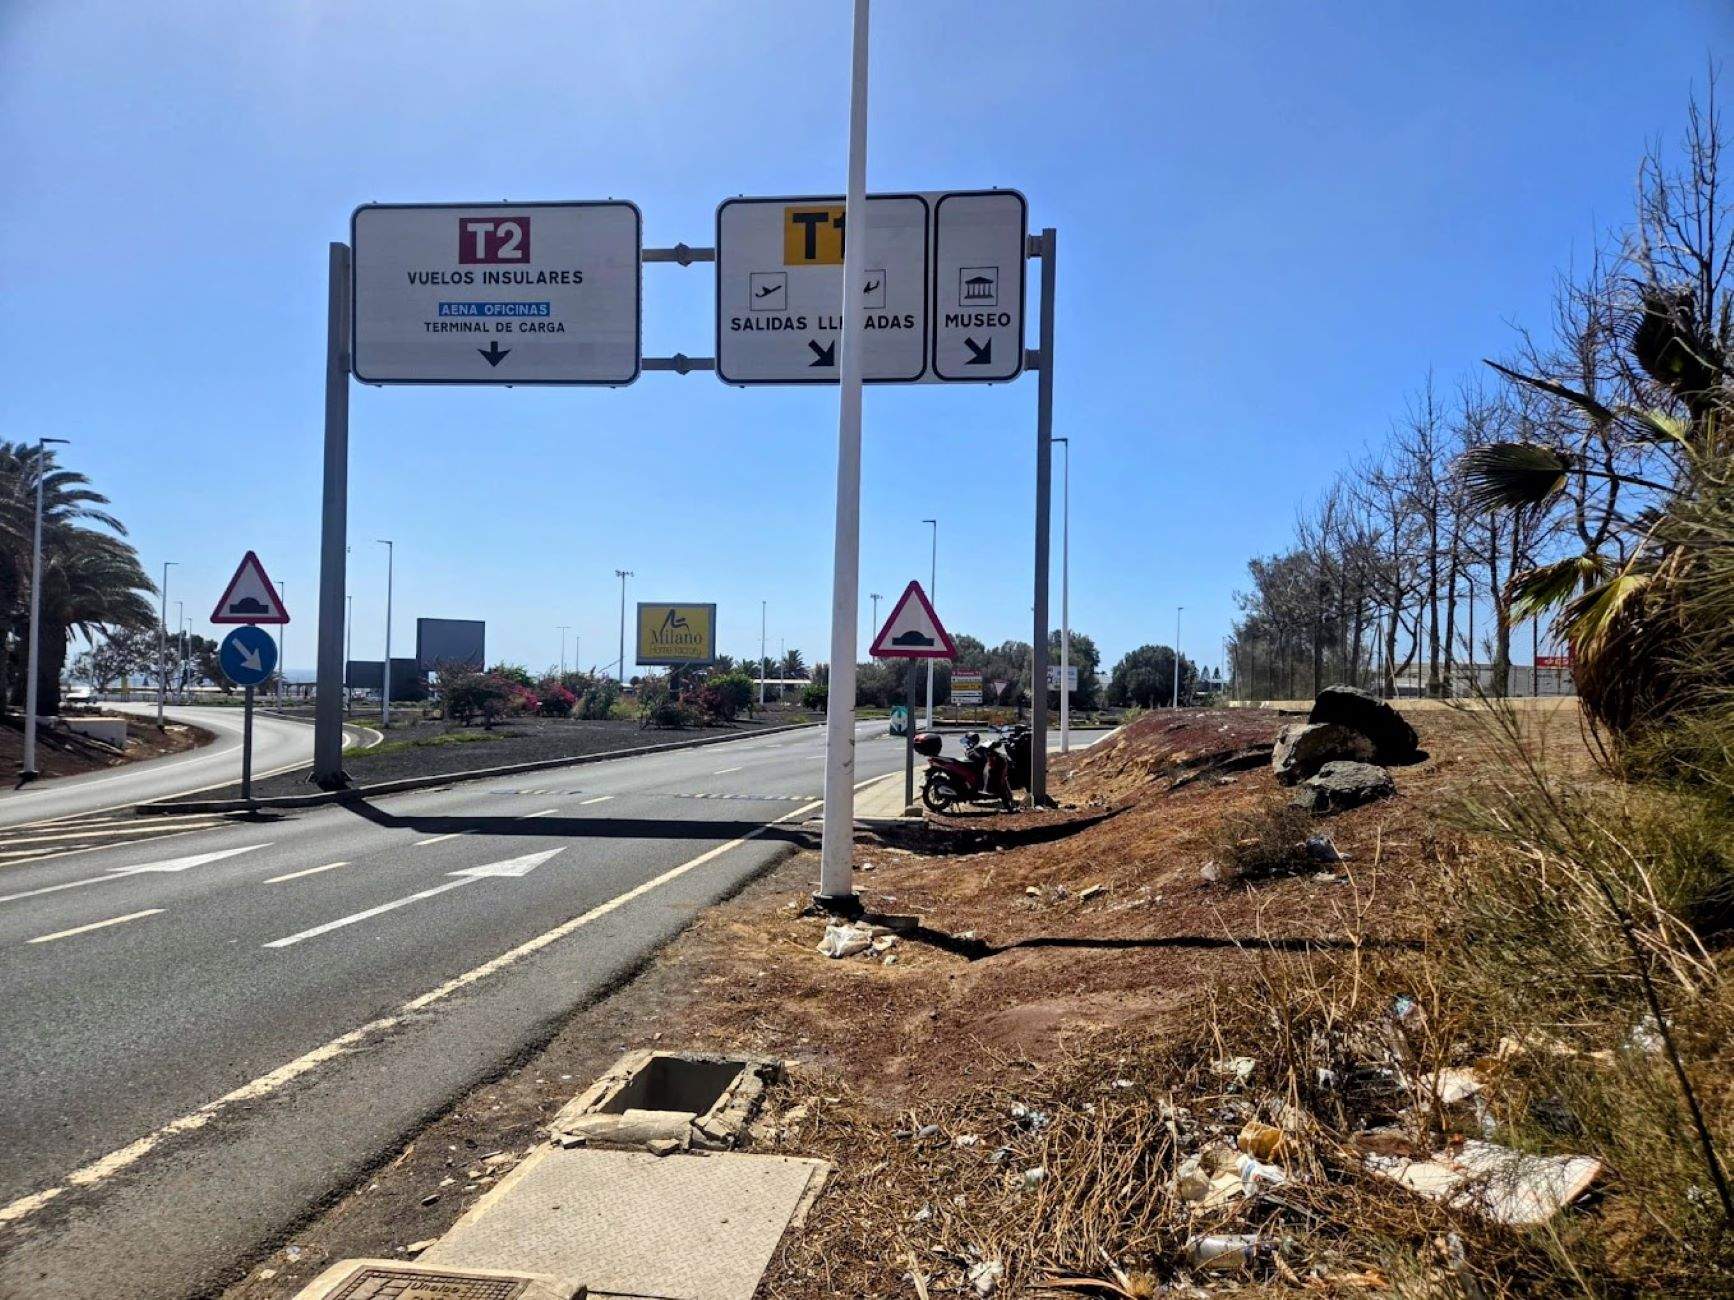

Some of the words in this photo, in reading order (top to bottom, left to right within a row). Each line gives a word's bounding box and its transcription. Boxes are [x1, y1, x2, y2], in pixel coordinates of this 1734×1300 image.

[467, 222, 523, 259] T2
[408, 271, 474, 285] VUELOS
[483, 271, 583, 285] INSULARES
[441, 304, 478, 316] AENA
[484, 304, 548, 315] OFICINAS
[424, 322, 490, 333] TERMINAL
[496, 322, 513, 333] DE
[519, 322, 565, 333] CARGA
[730, 316, 808, 331] SALIDAS
[945, 313, 1011, 328] MUSEO
[650, 630, 702, 645] Milano
